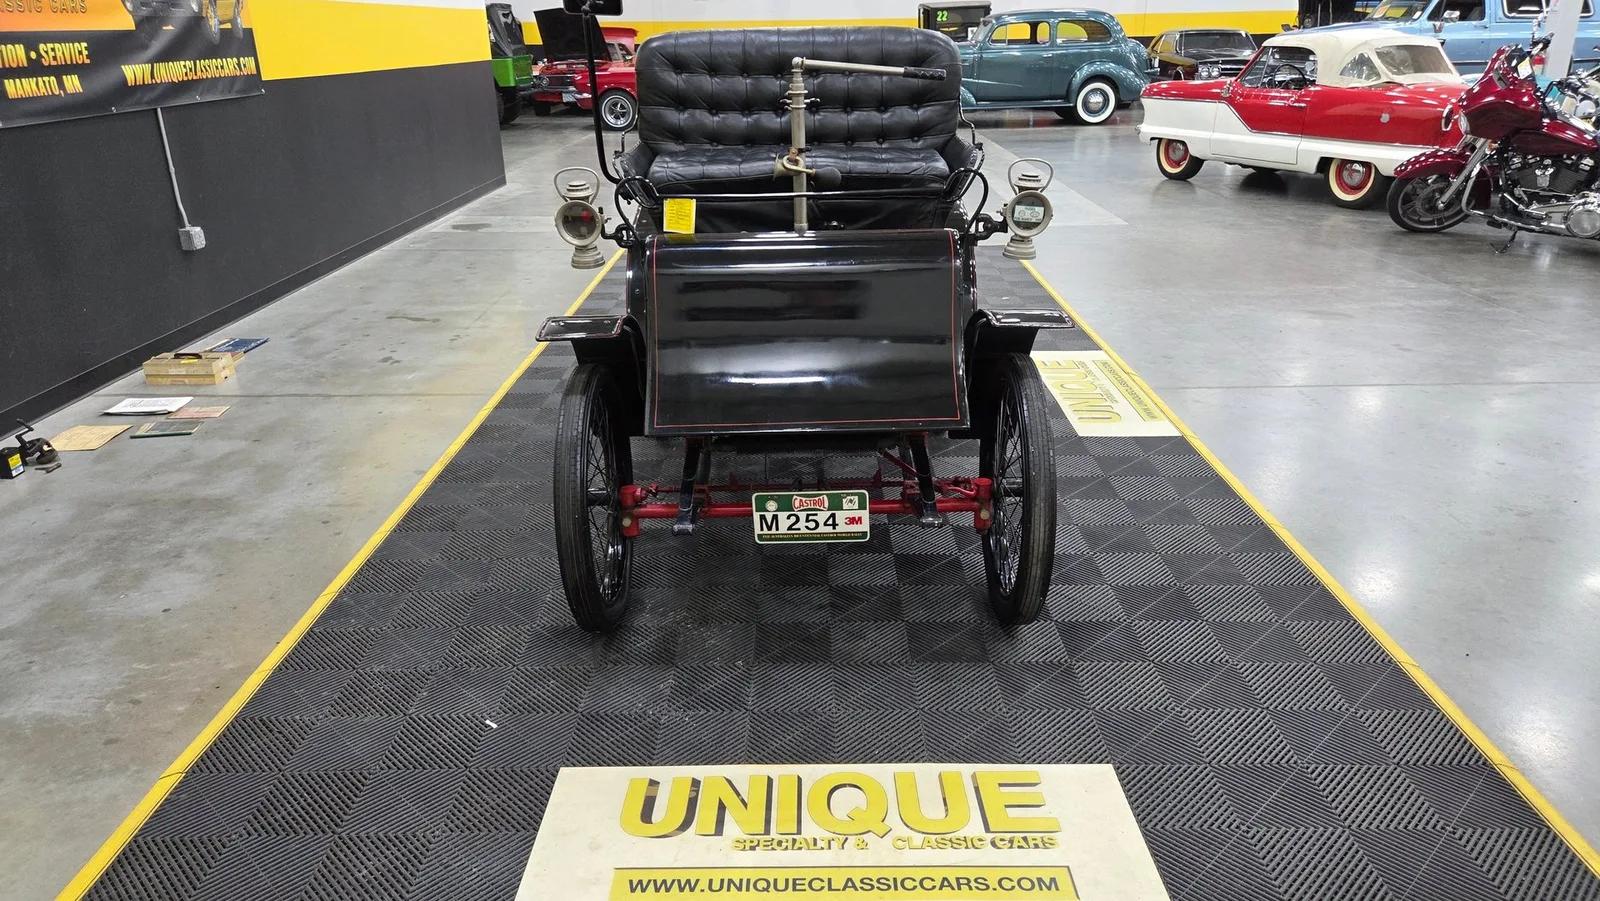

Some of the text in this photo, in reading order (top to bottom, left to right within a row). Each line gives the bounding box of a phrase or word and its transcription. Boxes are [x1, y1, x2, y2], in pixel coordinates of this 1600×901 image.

[0, 0, 88, 13] SSIC CARS
[936, 10, 948, 21] 22
[39, 42, 90, 66] SERVICE
[121, 56, 257, 87] WWW.UNIQUECLASSICCARS.COM
[4, 74, 83, 99] MANKATO, MN
[793, 497, 827, 510] CASTROL
[759, 512, 839, 531] M 254
[844, 516, 862, 525] 3M
[620, 770, 1062, 838] UNIQUE
[731, 835, 1060, 851] SPECIALTY & CLASSIC CARS
[628, 876, 1060, 893] WWW.UNIQUECLASSICCARS.COM
